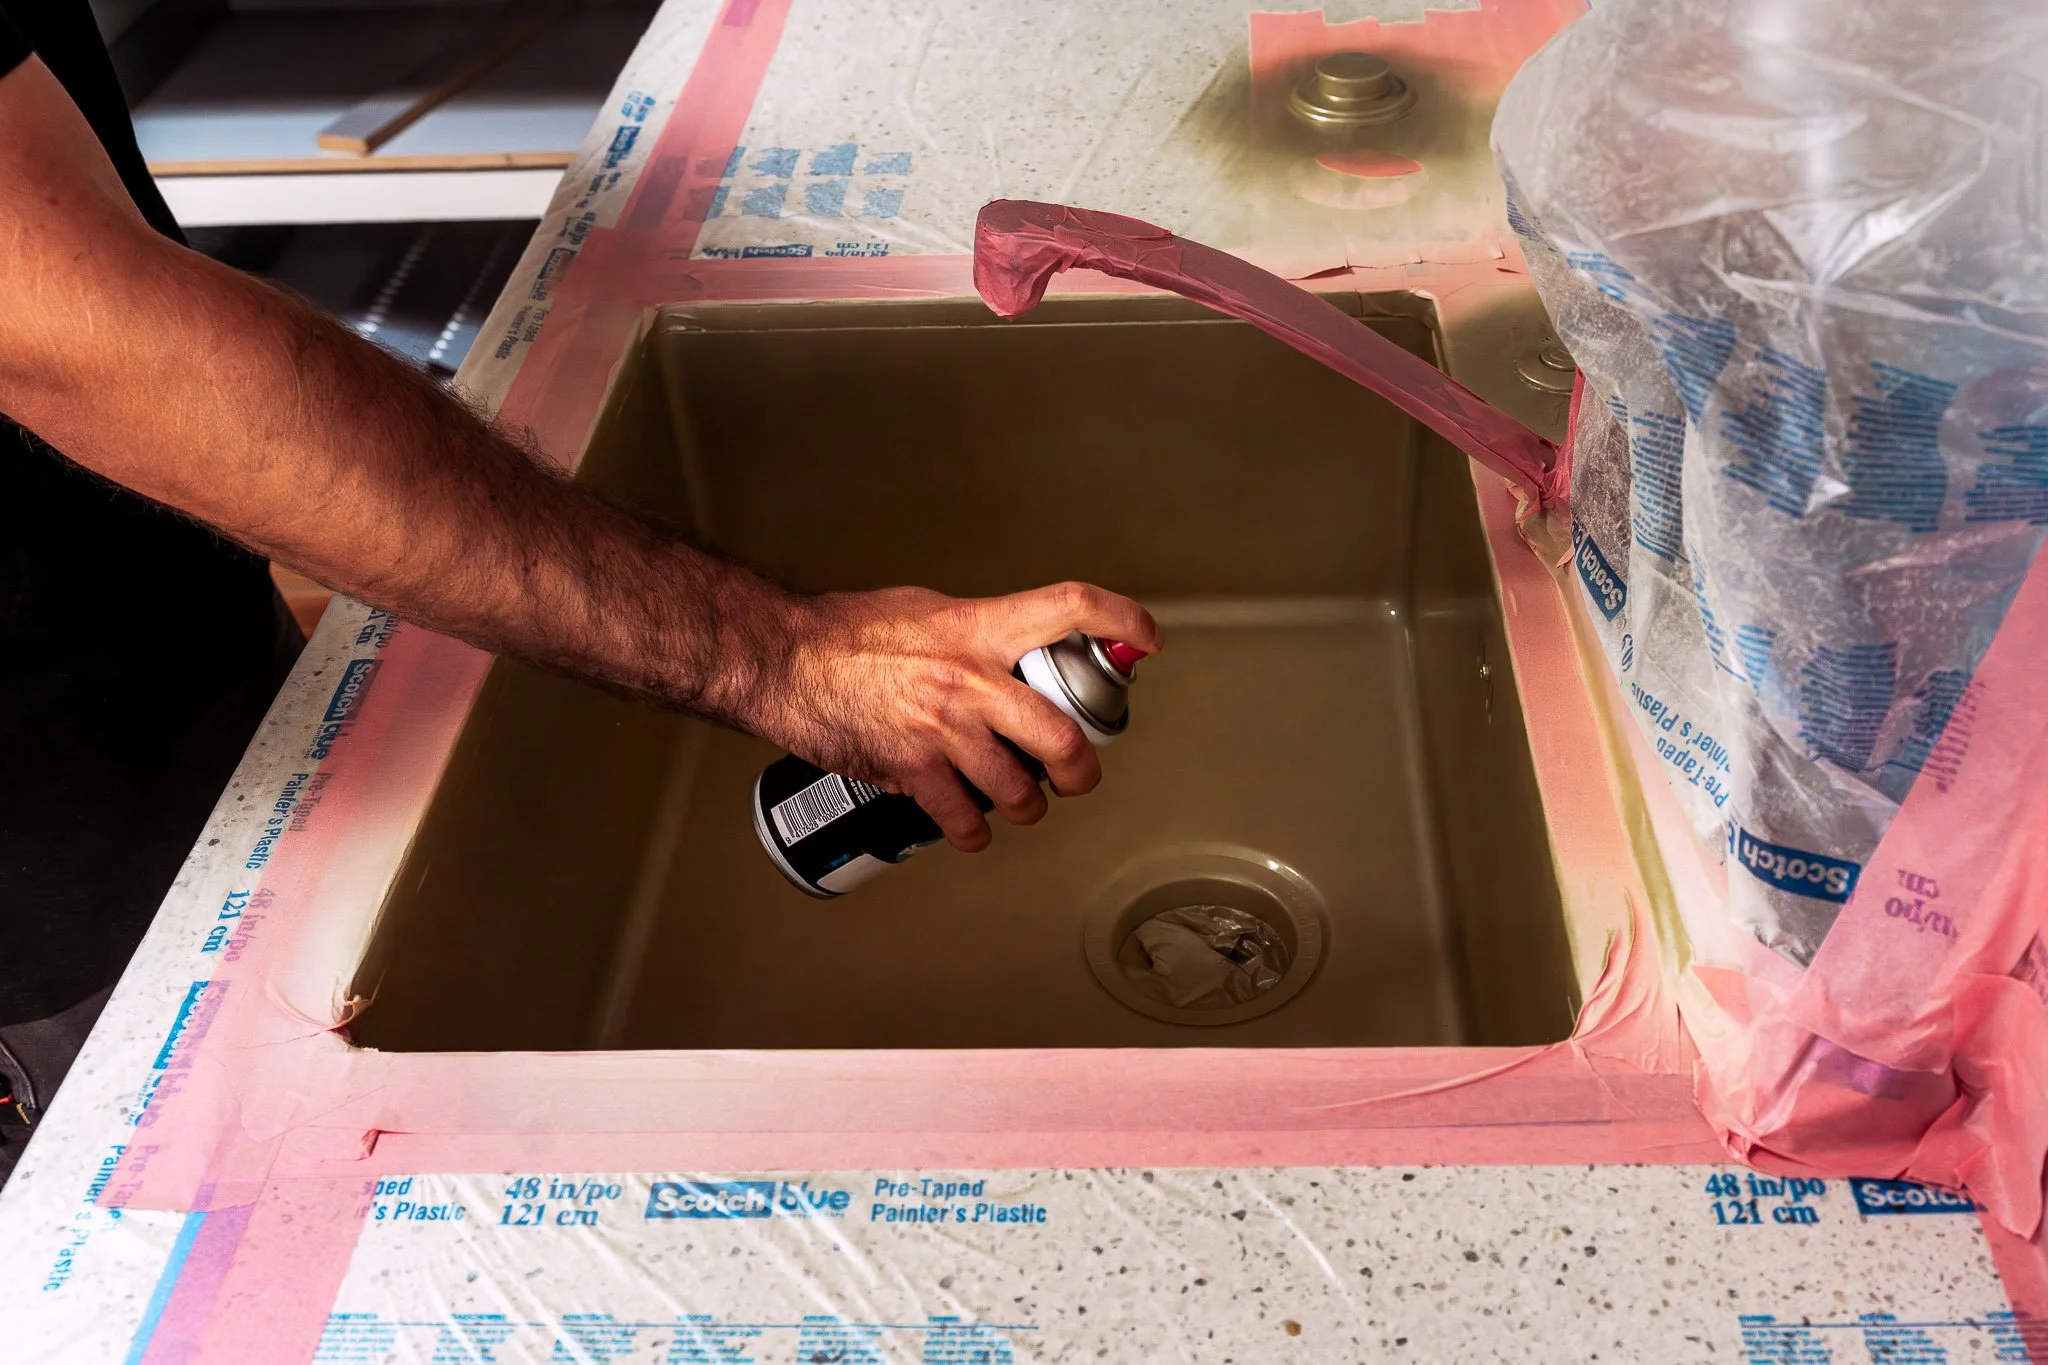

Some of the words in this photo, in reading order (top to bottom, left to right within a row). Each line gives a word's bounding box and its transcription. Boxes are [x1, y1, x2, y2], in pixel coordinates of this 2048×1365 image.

[1581, 544, 1624, 611] Scotch
[355, 623, 377, 646] cm
[267, 772, 310, 826] Painter's
[785, 836, 793, 845] 9
[794, 820, 820, 839] 417528
[821, 804, 848, 823] 000015
[245, 826, 283, 870] Plastic
[1743, 837, 1850, 894] Scotch
[217, 889, 250, 921] 121
[200, 925, 229, 953] cm
[505, 1176, 541, 1201] 48
[547, 1176, 623, 1206] in/po
[653, 1185, 769, 1214] Scotch
[779, 1180, 851, 1211] blue
[874, 1177, 987, 1201] Pre-Taped
[1704, 1172, 1742, 1198] 48
[1747, 1172, 1827, 1204] in/po
[1861, 1182, 1970, 1208] Scotc
[393, 1202, 468, 1222] Plastic
[498, 1203, 547, 1227] 121
[555, 1208, 600, 1227] cm
[870, 1202, 967, 1224] Painter's
[974, 1202, 1048, 1224] Plastic
[1711, 1198, 1766, 1226] 121
[1771, 1204, 1821, 1226] cm
